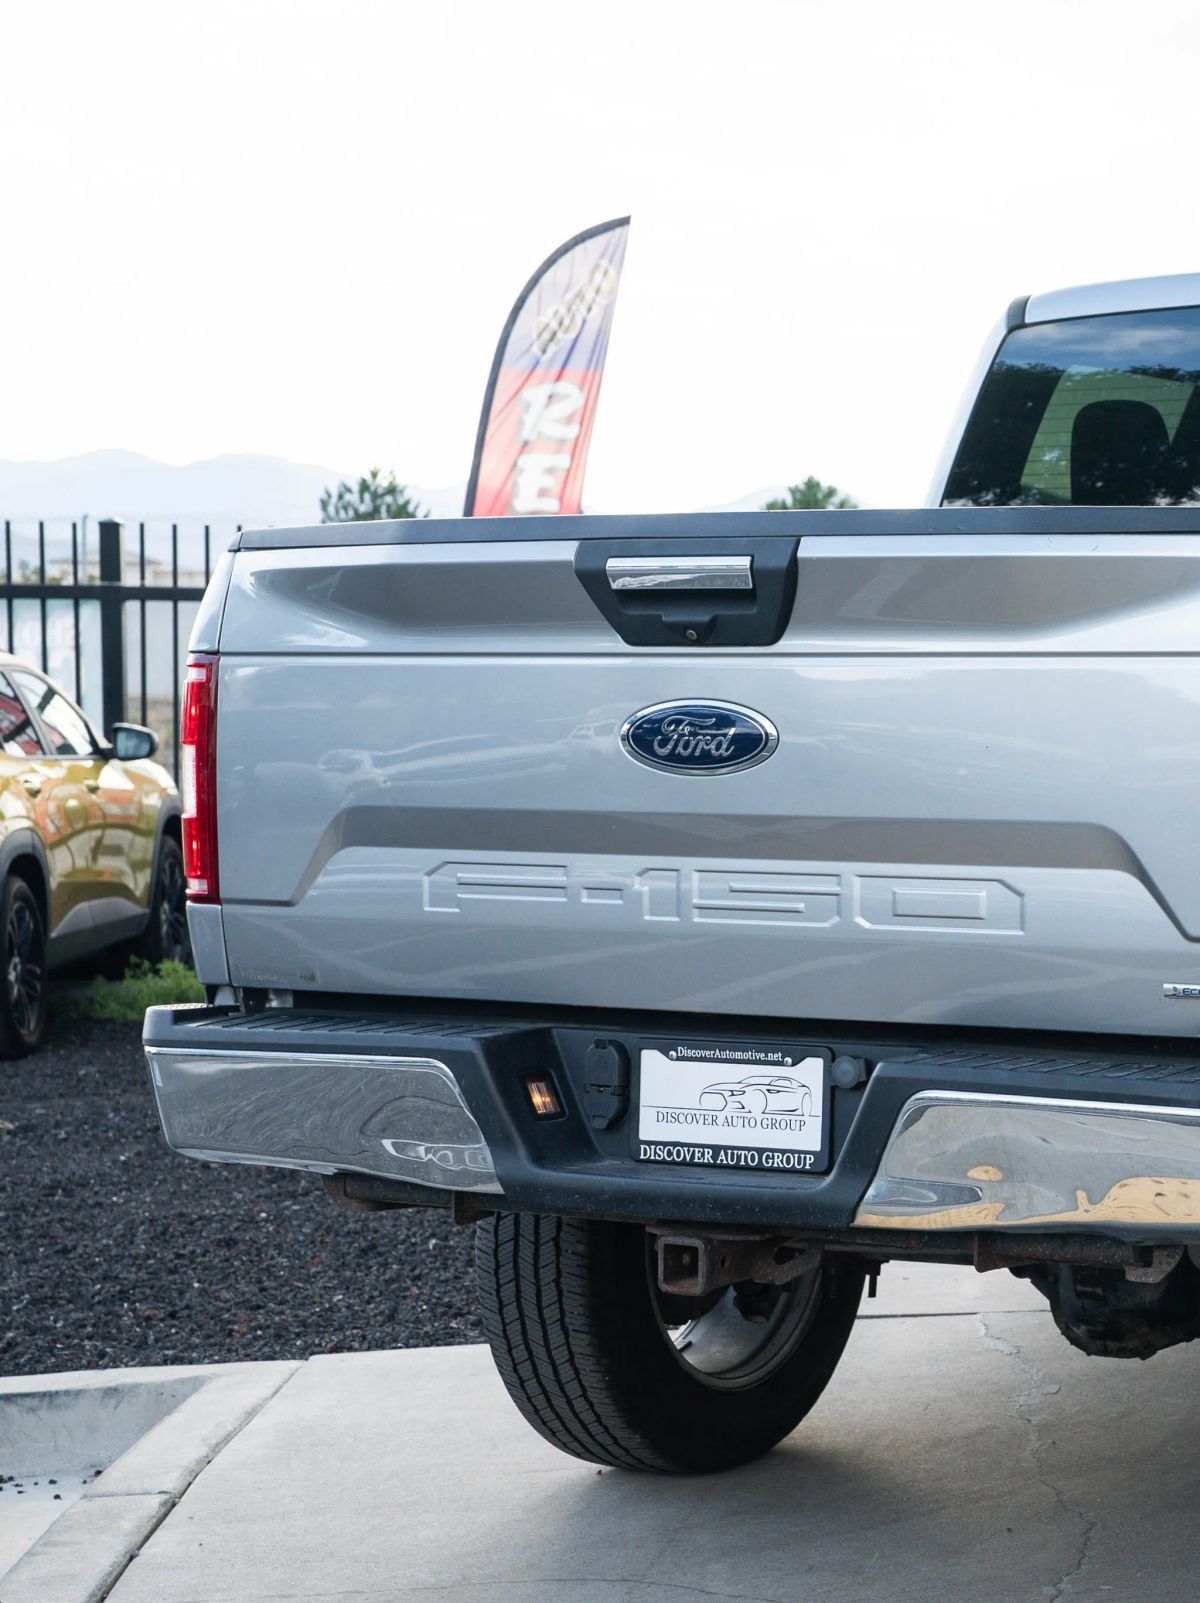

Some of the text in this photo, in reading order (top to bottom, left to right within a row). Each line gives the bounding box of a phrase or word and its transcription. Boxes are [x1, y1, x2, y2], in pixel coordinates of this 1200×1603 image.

[654, 716, 737, 758] Ford
[422, 861, 1026, 935] F-150
[677, 1046, 783, 1061] DiscoverAutomotive.net
[656, 1111, 806, 1131] DISCOVER AUTO GROUP
[639, 1144, 815, 1169] DISCOVER AUTO GROUP
